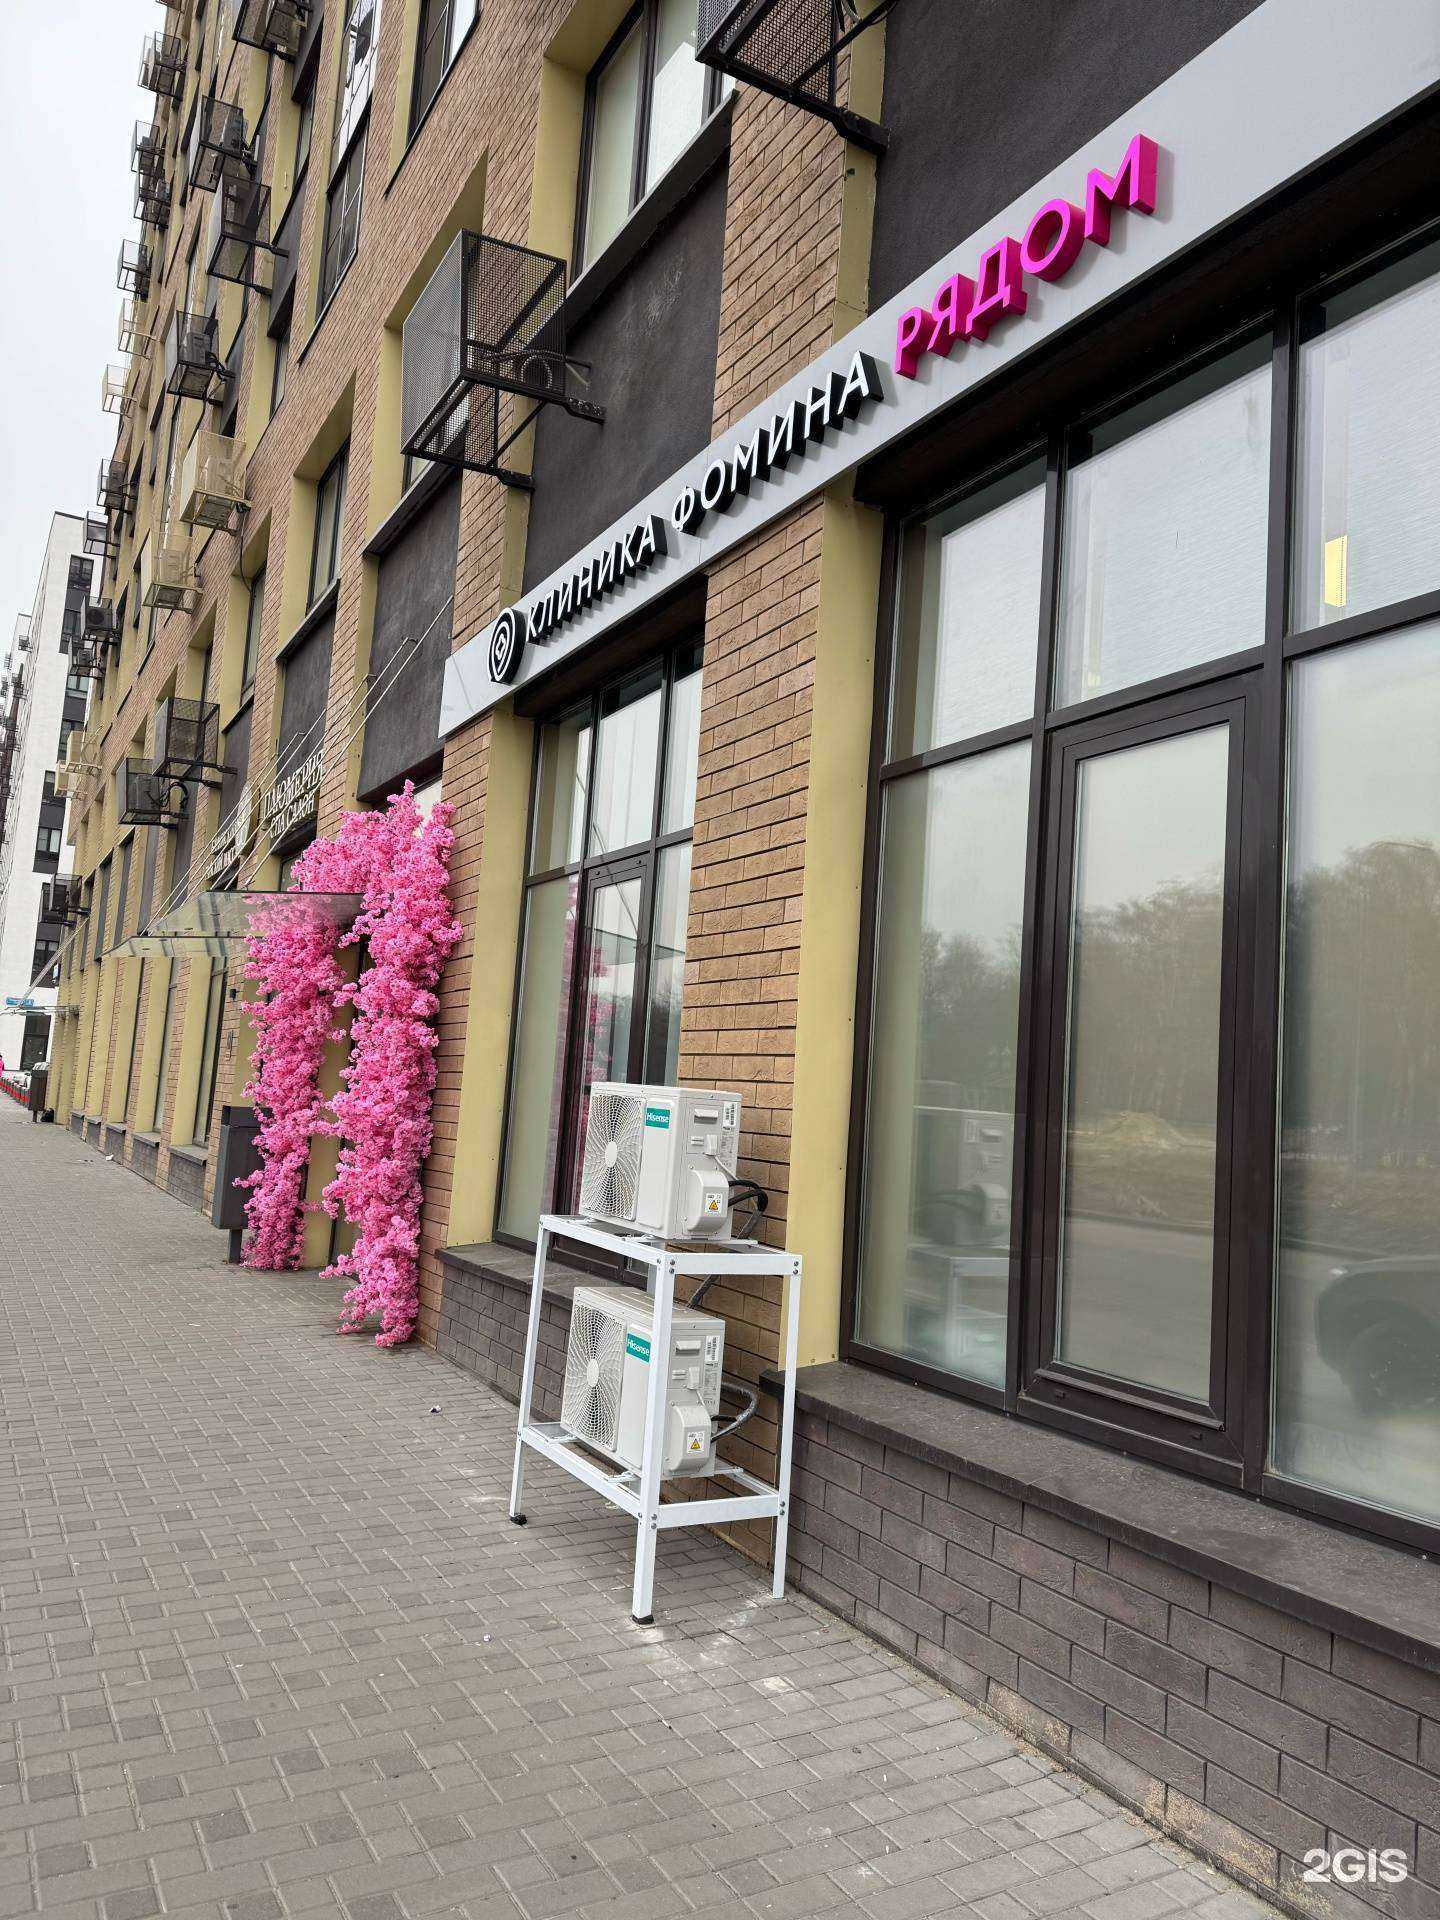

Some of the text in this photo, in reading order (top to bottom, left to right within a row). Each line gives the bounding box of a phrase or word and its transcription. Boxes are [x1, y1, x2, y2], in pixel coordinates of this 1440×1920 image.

[526, 134, 1158, 644] КЛИНИКА ФОМИНА РЯДОМ
[646, 1111, 670, 1123] Hisense
[626, 1337, 651, 1356] Hisense
